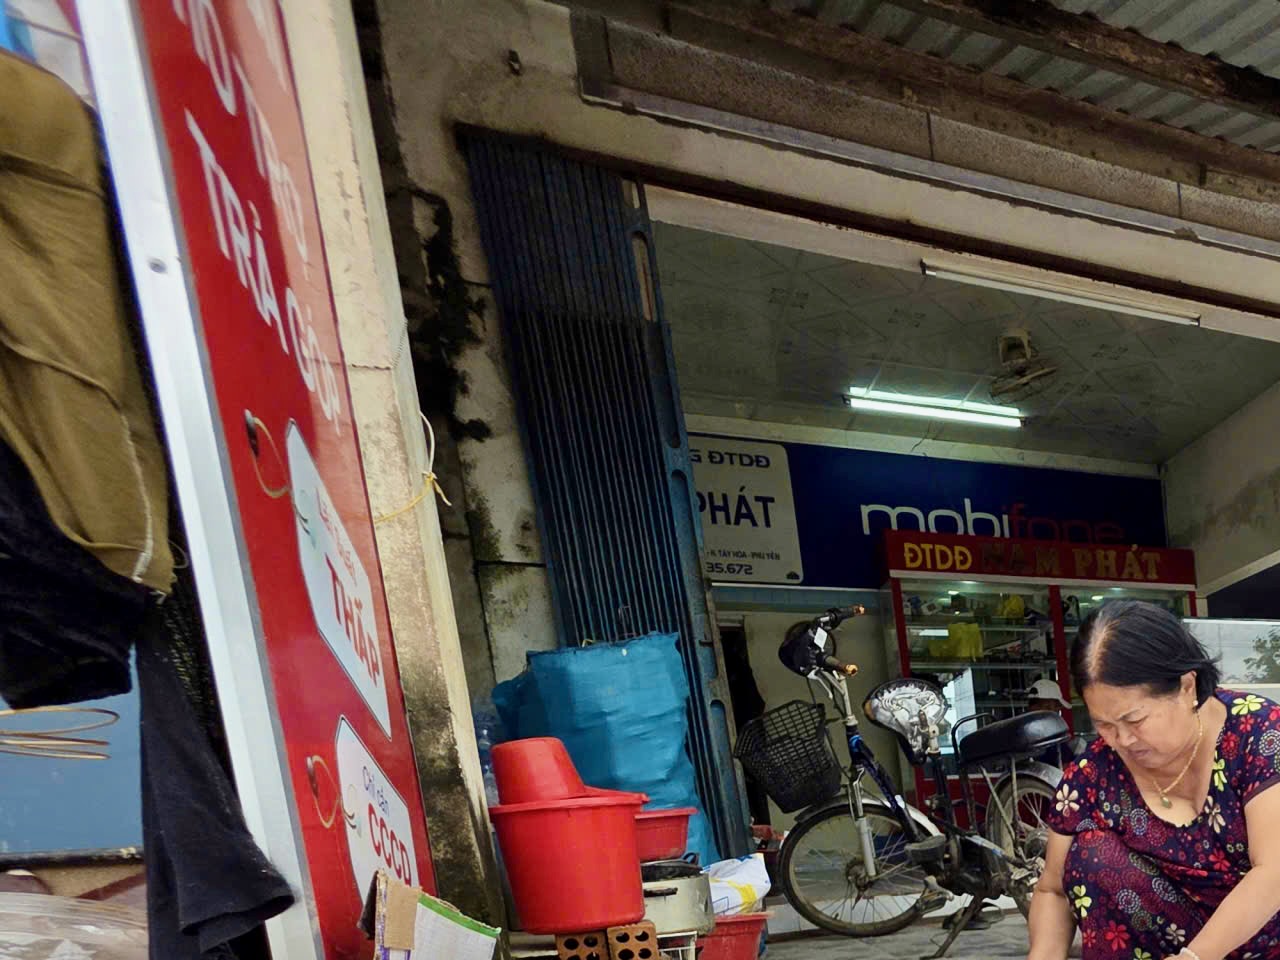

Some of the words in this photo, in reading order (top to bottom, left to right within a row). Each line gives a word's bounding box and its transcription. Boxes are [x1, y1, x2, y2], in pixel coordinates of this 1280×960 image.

[708, 451, 771, 468] ĐTDĐ
[903, 542, 973, 571] ĐTDĐ
[1072, 543, 1161, 580] PHÁT
[368, 802, 412, 888] CCCD
